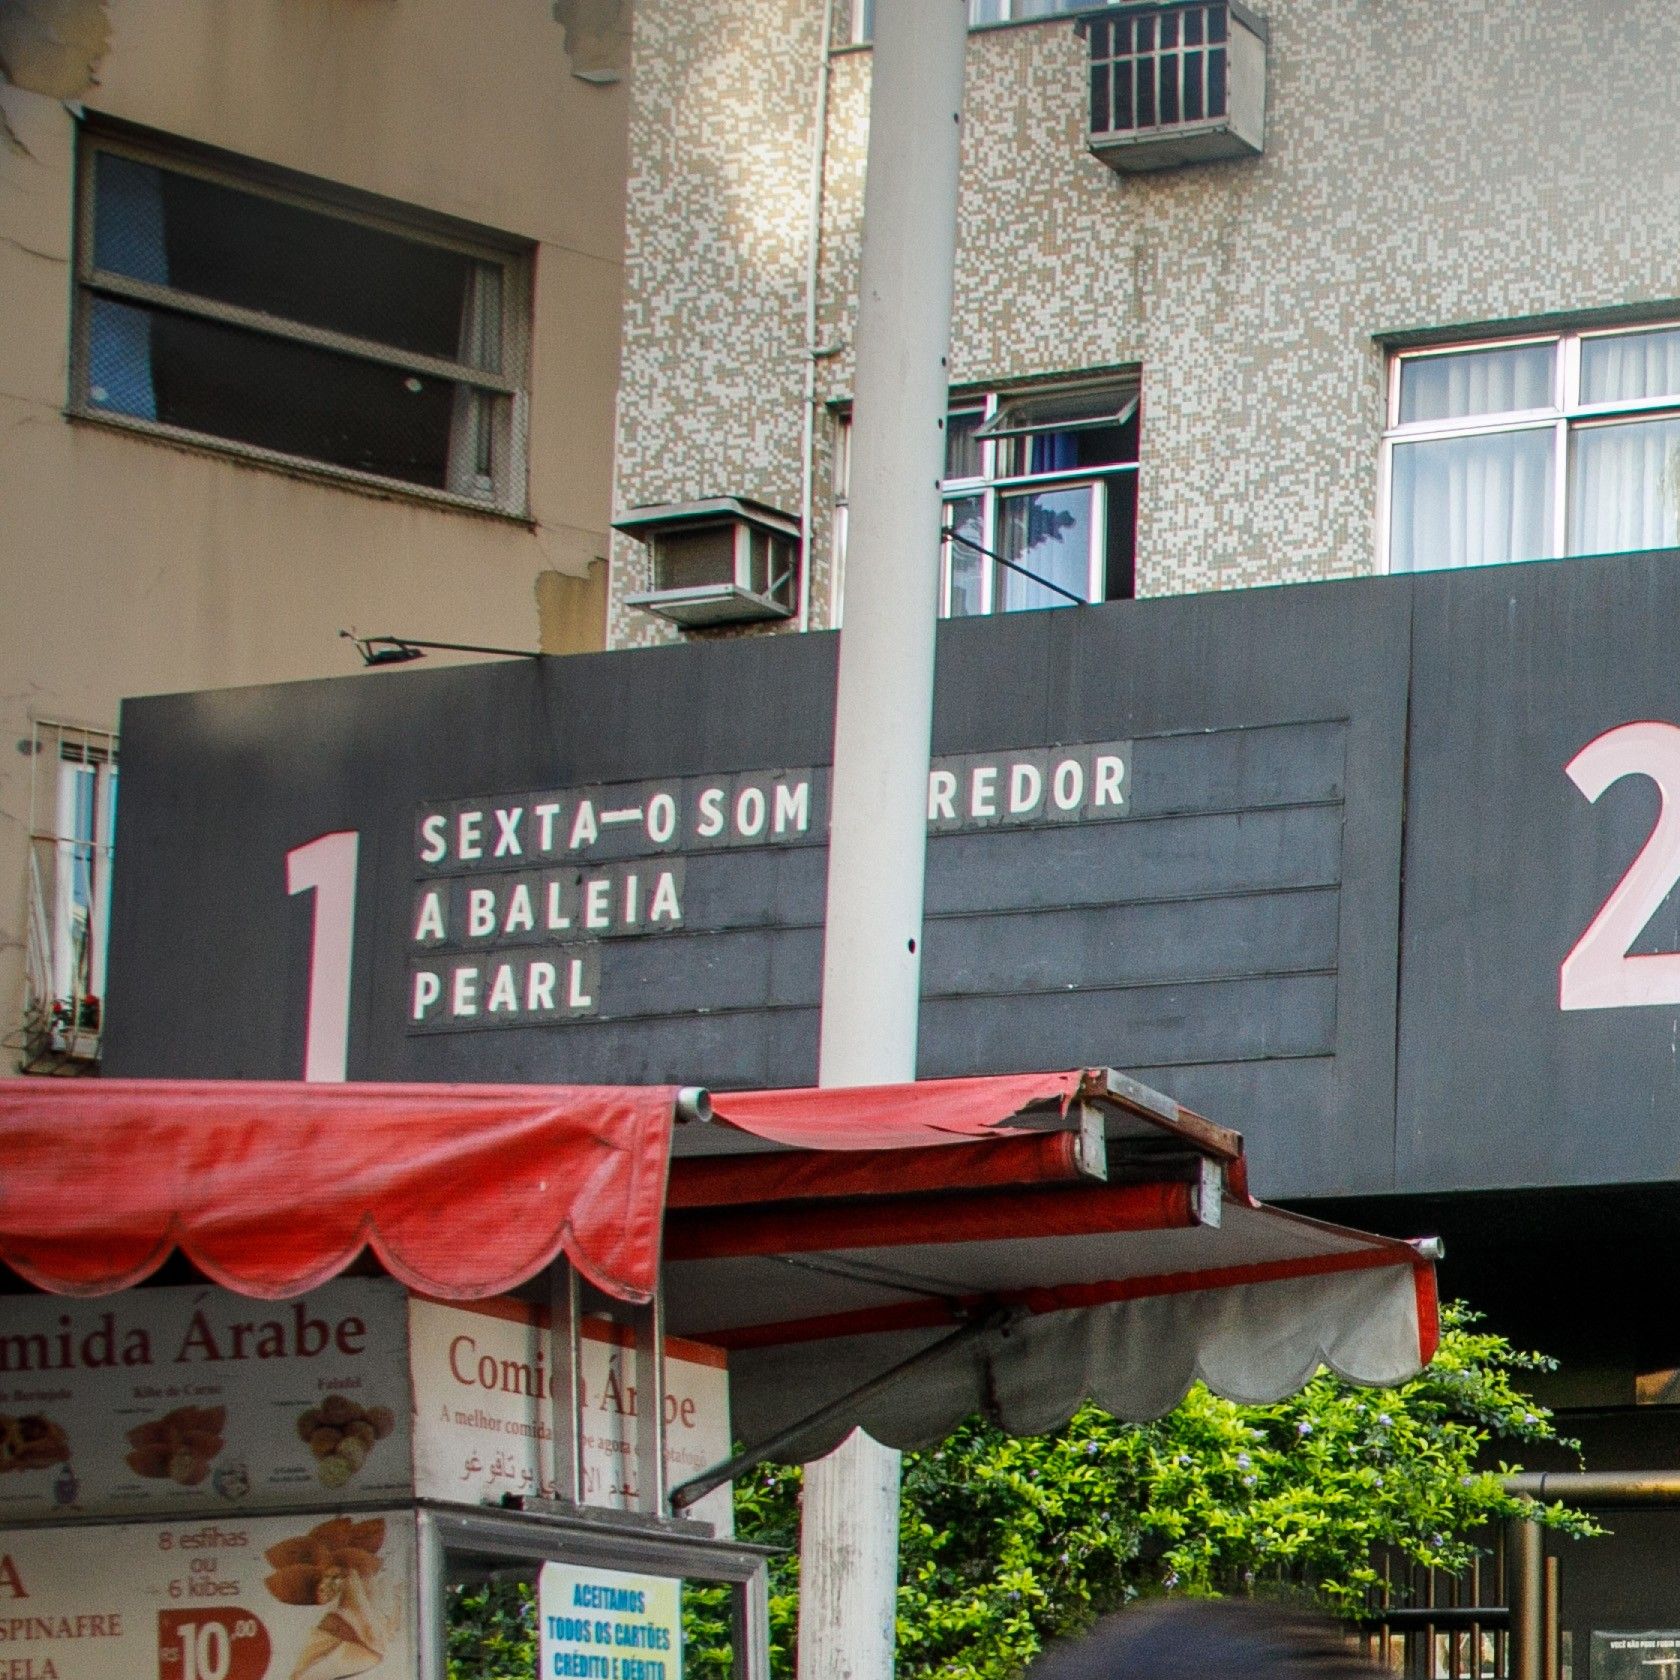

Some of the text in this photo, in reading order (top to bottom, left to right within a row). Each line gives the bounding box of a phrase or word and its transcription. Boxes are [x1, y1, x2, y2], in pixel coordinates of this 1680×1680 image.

[696, 781, 809, 838] SOM
[927, 754, 1126, 821] REDOR
[414, 871, 682, 941] A BALEIA
[286, 829, 360, 1083] 1
[412, 958, 593, 1020] PEARL
[0, 1290, 367, 1372] mida Árabe
[0, 1613, 122, 1641] SPINAFRE
[572, 1583, 646, 1615] ACEITAMOS
[547, 1616, 671, 1651] TODOS OS CARTÕES
[554, 1649, 610, 1680] CRÉDITO
[612, 1655, 620, 1680] E
